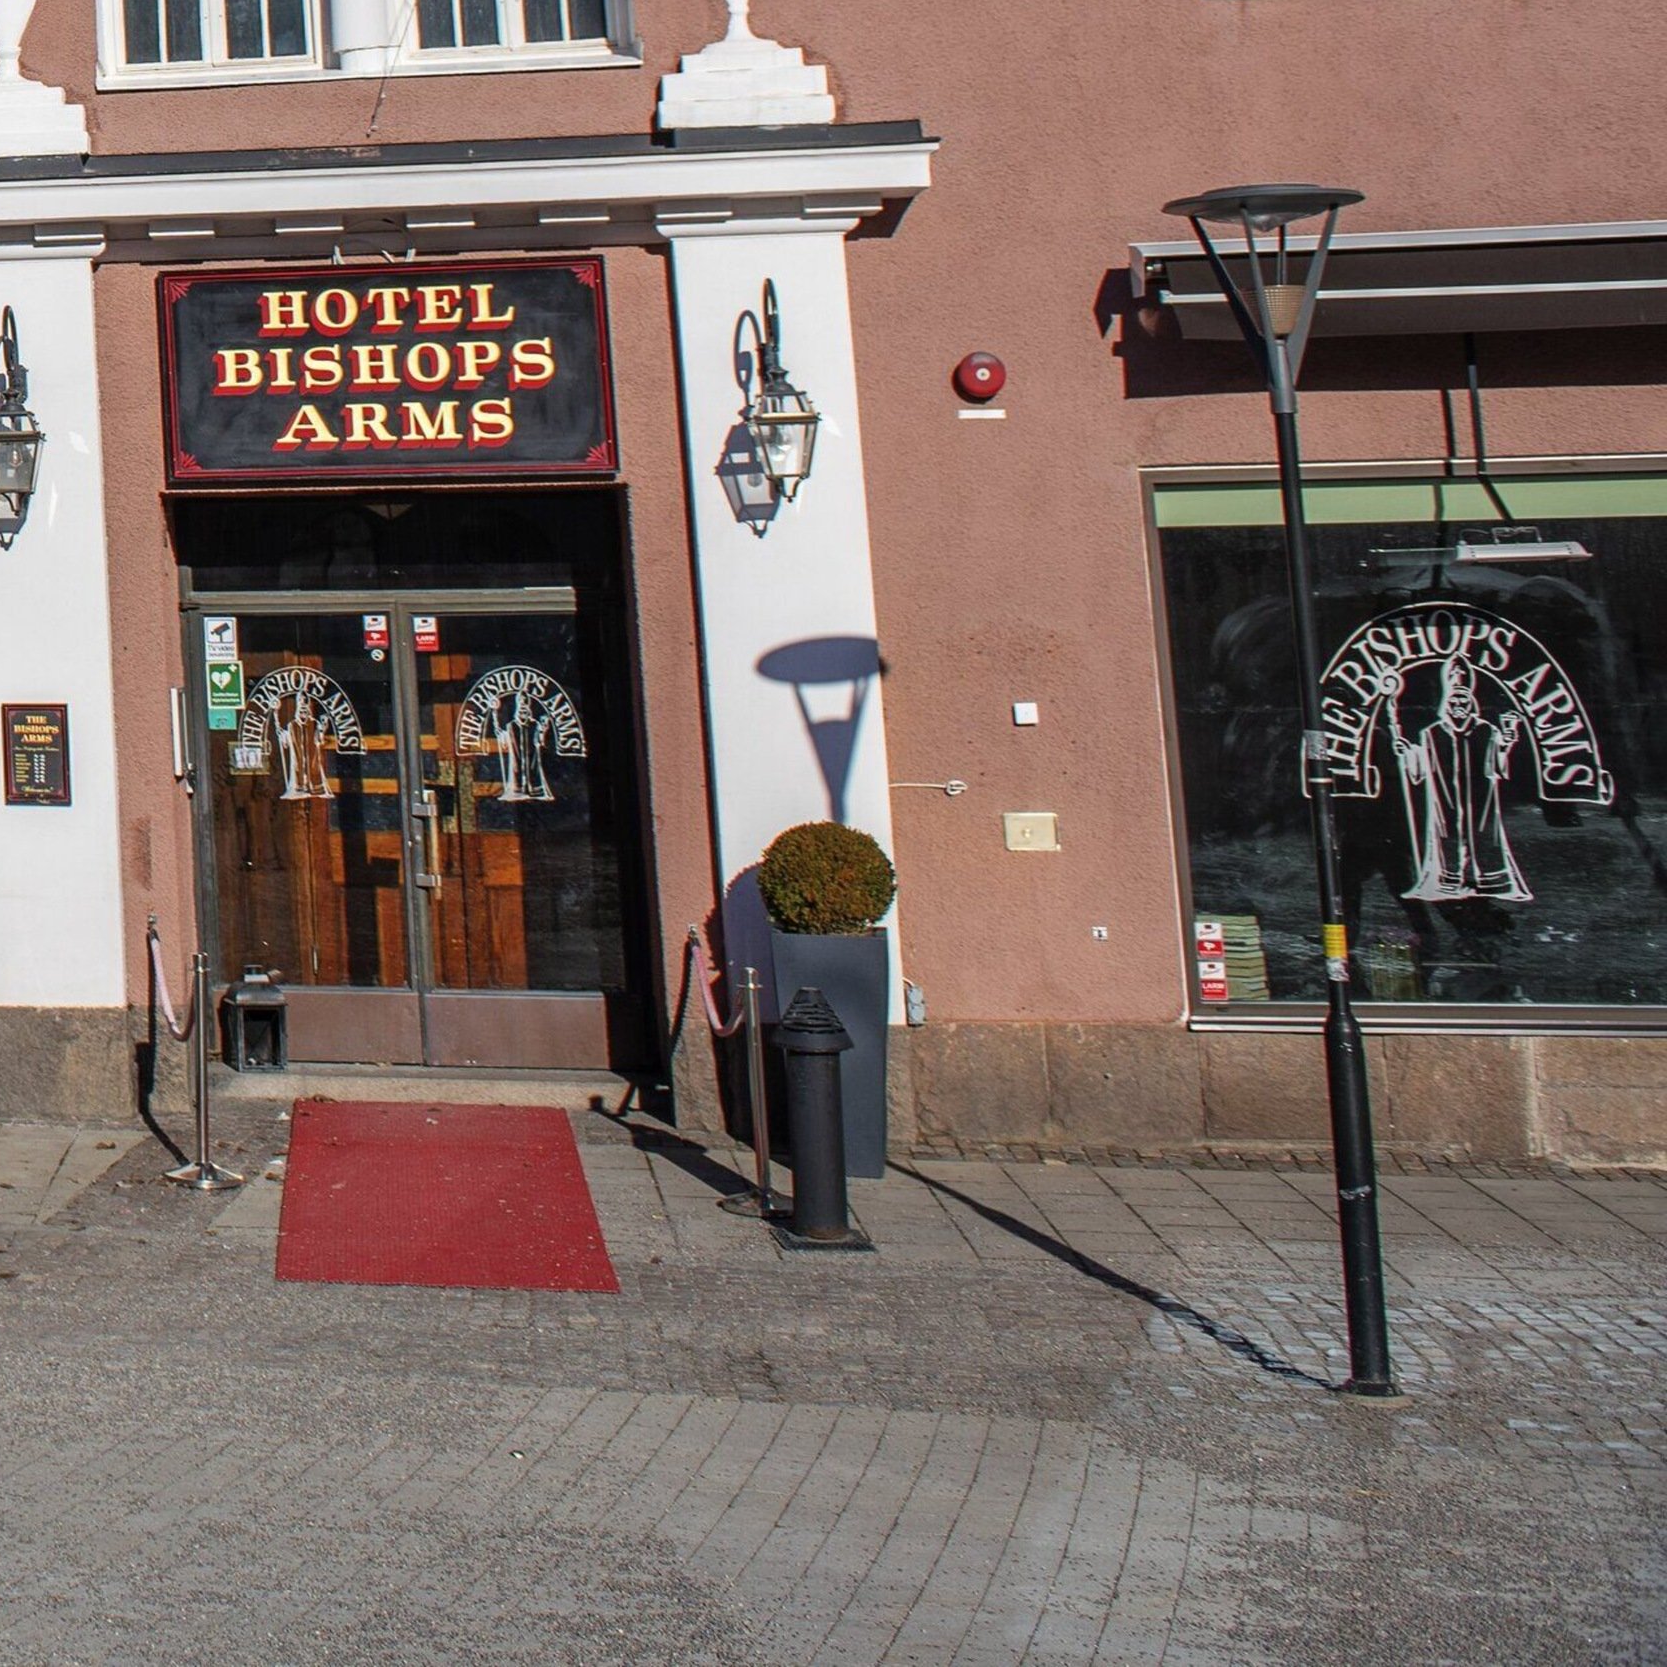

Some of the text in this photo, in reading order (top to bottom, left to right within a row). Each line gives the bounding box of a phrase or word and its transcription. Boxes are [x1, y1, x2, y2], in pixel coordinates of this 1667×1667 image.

[257, 283, 515, 337] HOTEL
[213, 337, 555, 395] BISHOPS
[272, 397, 515, 452] ARMS
[26, 716, 47, 724] THE
[241, 668, 360, 750] THE BISHOPS ARMS
[460, 668, 581, 749] THE BISHOPS ARMS
[1330, 610, 1516, 707] BISHOPS
[1504, 662, 1596, 787] ARMS
[14, 725, 60, 734] BISHOPS
[21, 734, 53, 744] ARMS
